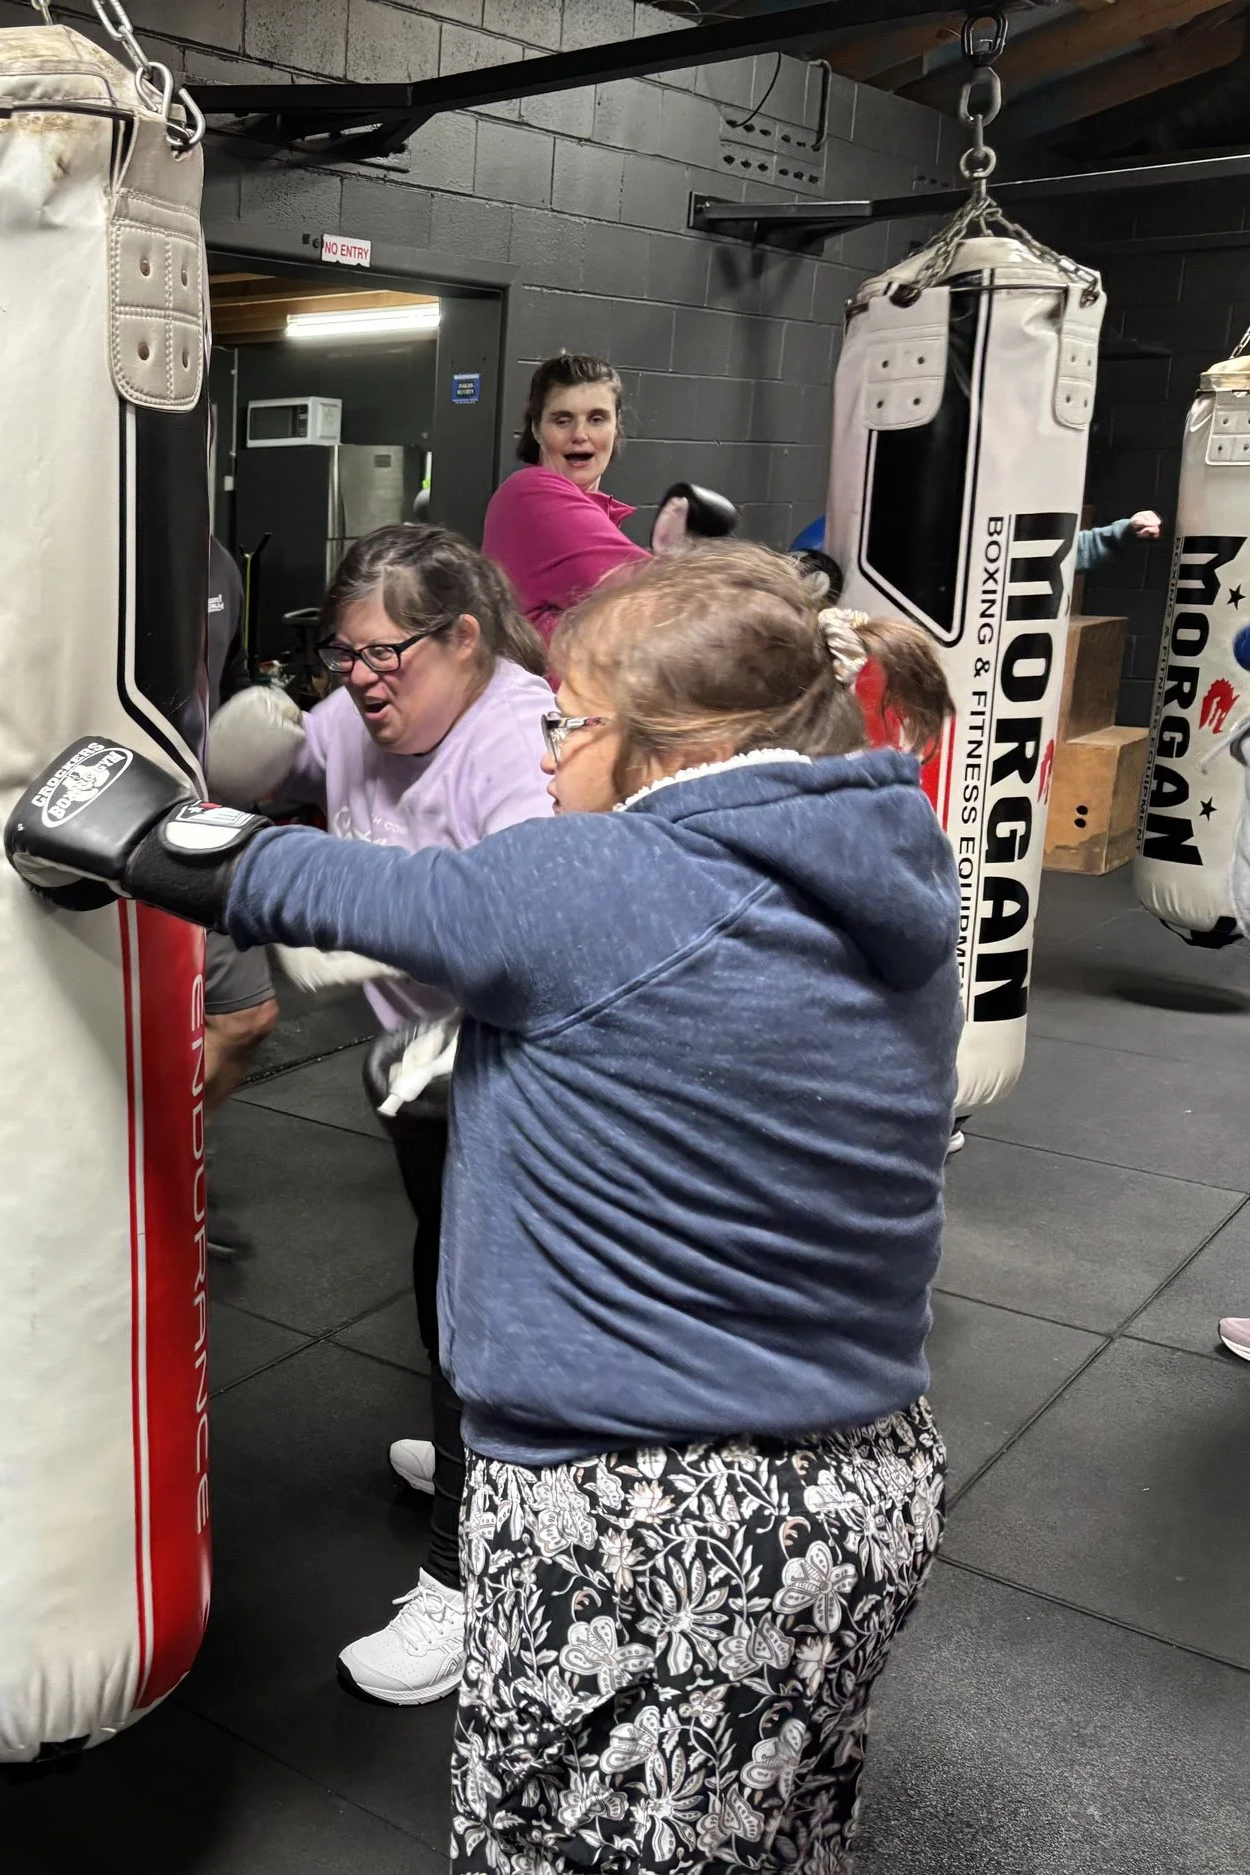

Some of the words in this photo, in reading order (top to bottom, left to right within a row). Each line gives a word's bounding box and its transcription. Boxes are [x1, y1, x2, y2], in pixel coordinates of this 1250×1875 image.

[324, 241, 338, 255] NO
[340, 244, 370, 260] ENTRY
[977, 516, 1004, 645] BOXING
[973, 657, 990, 679] &
[1143, 536, 1248, 866] MORGAN
[31, 742, 105, 807] CROCKERS
[95, 751, 126, 772] GYM
[961, 691, 988, 825] FITNESS
[973, 512, 1078, 1022] MORGAN
[956, 836, 975, 1000] EQUIPM
[191, 973, 209, 1534] ENDURANCE
